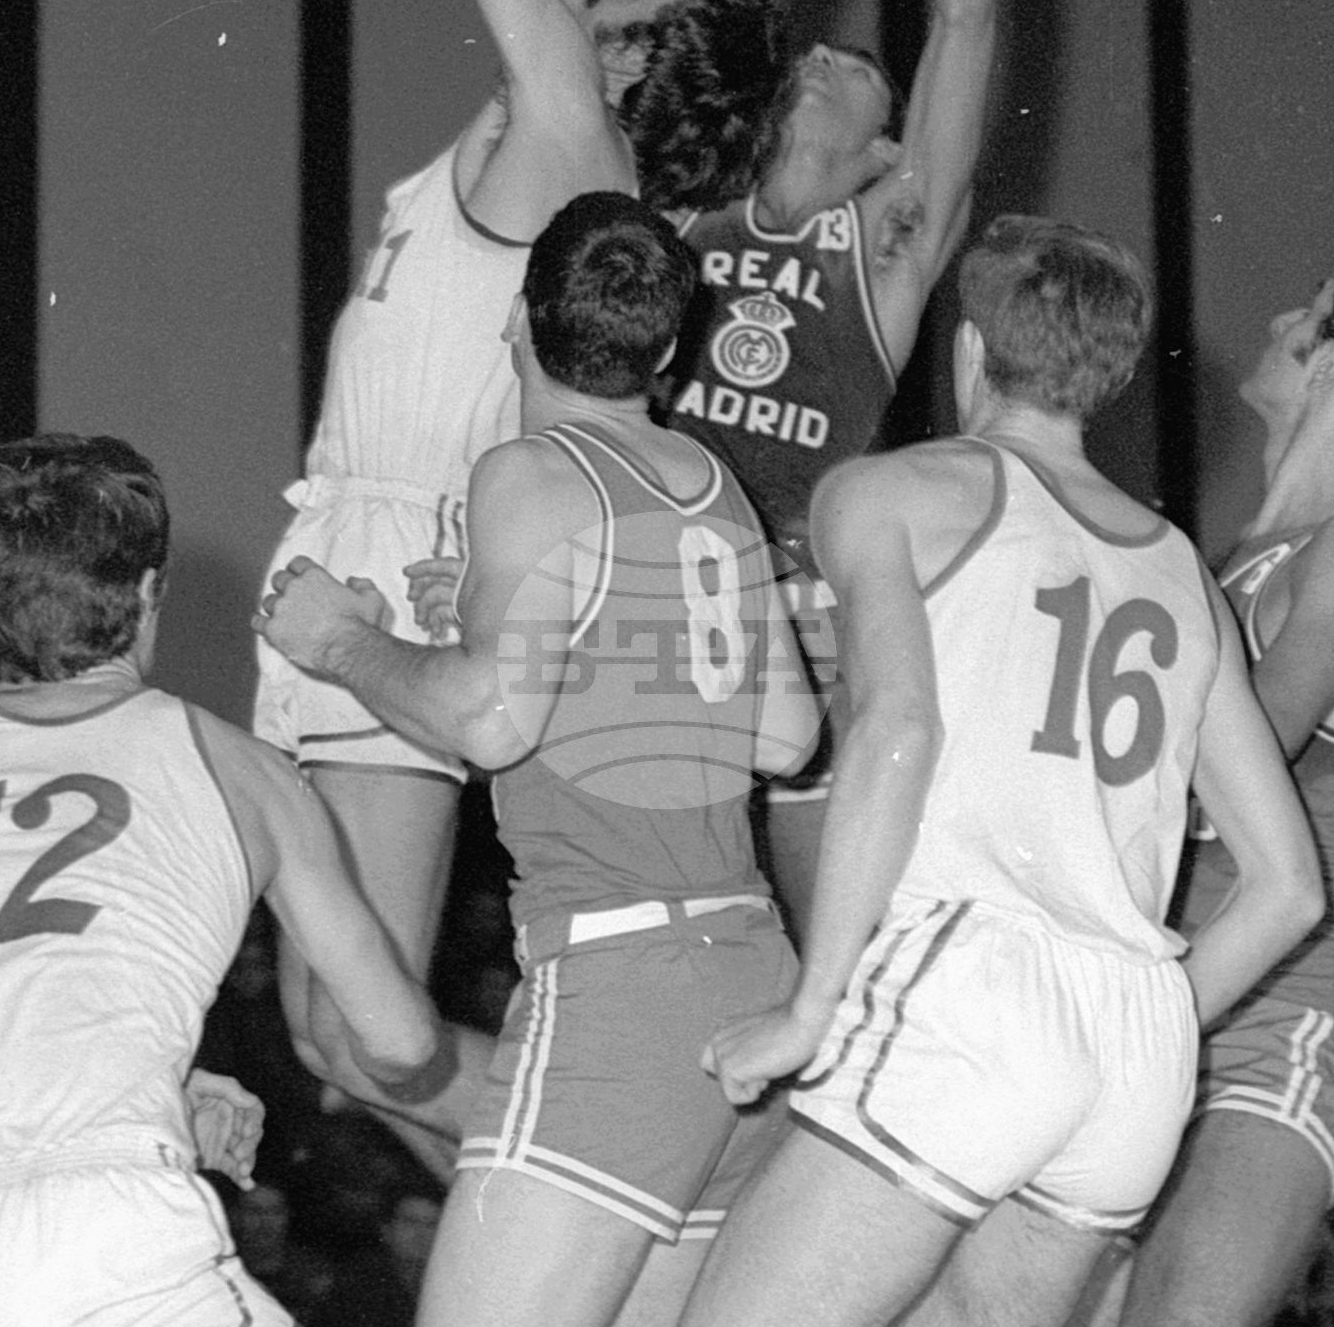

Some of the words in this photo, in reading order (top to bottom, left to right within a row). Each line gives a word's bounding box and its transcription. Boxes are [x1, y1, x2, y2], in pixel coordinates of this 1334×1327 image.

[816, 207, 851, 251] 13
[702, 250, 826, 312] REAL
[676, 380, 830, 449] ADRID
[678, 525, 745, 702] 8
[1030, 575, 1179, 788] 16
